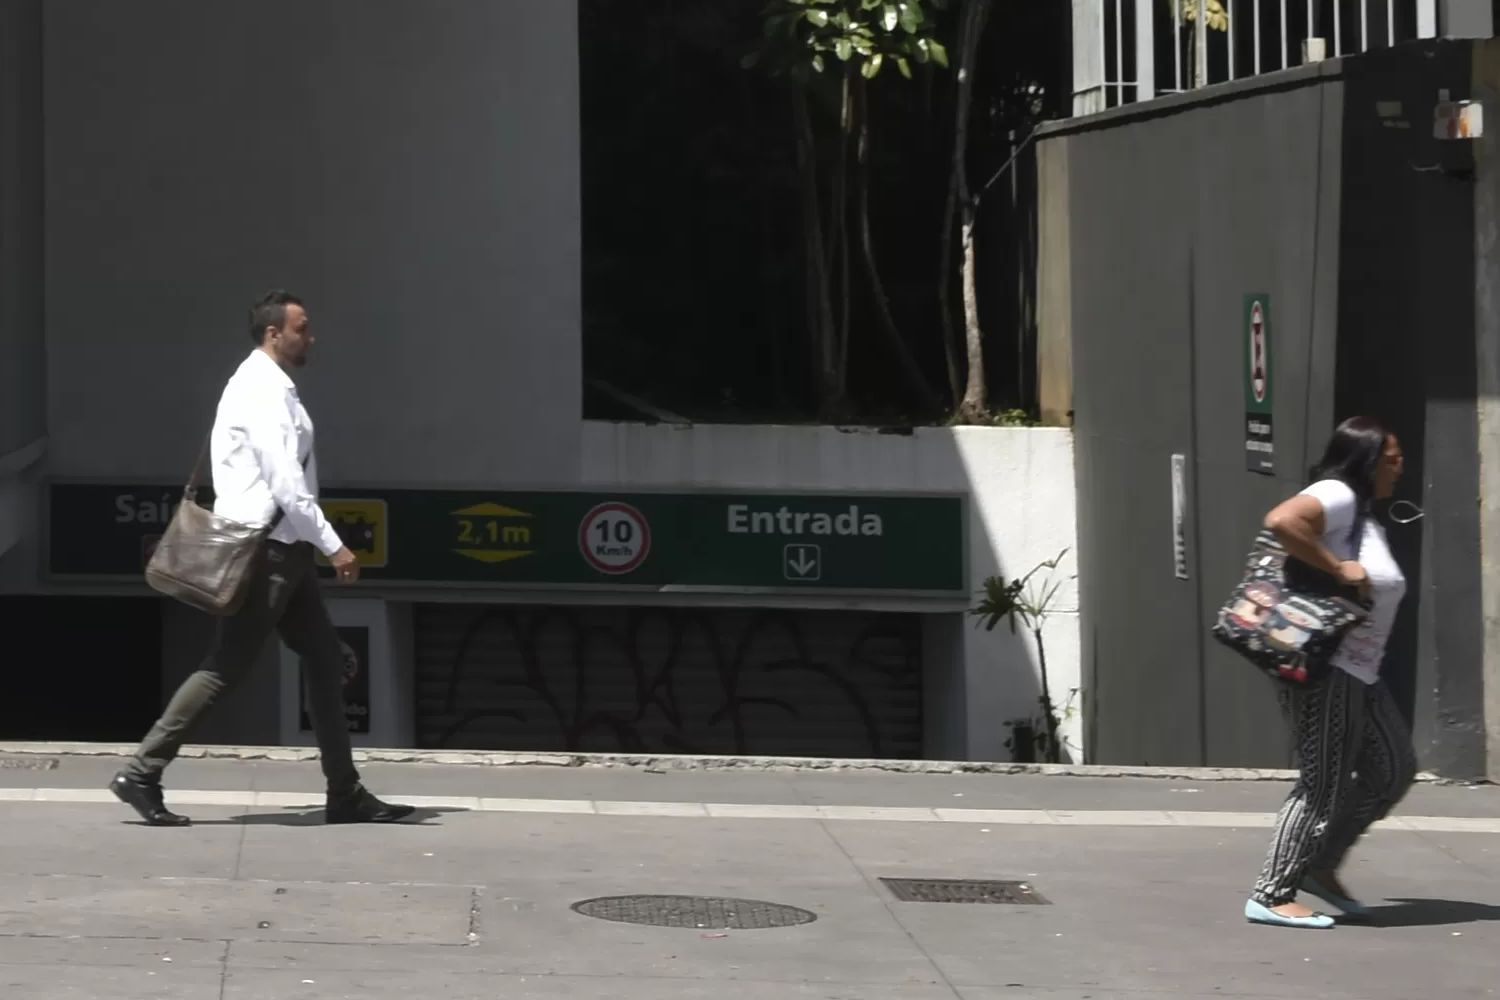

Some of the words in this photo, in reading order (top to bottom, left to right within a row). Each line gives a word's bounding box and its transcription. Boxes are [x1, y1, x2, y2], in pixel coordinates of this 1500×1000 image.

[114, 492, 177, 524] Saí
[727, 504, 883, 536] Entrada
[457, 519, 531, 545] 2,1m
[595, 519, 632, 543] 10
